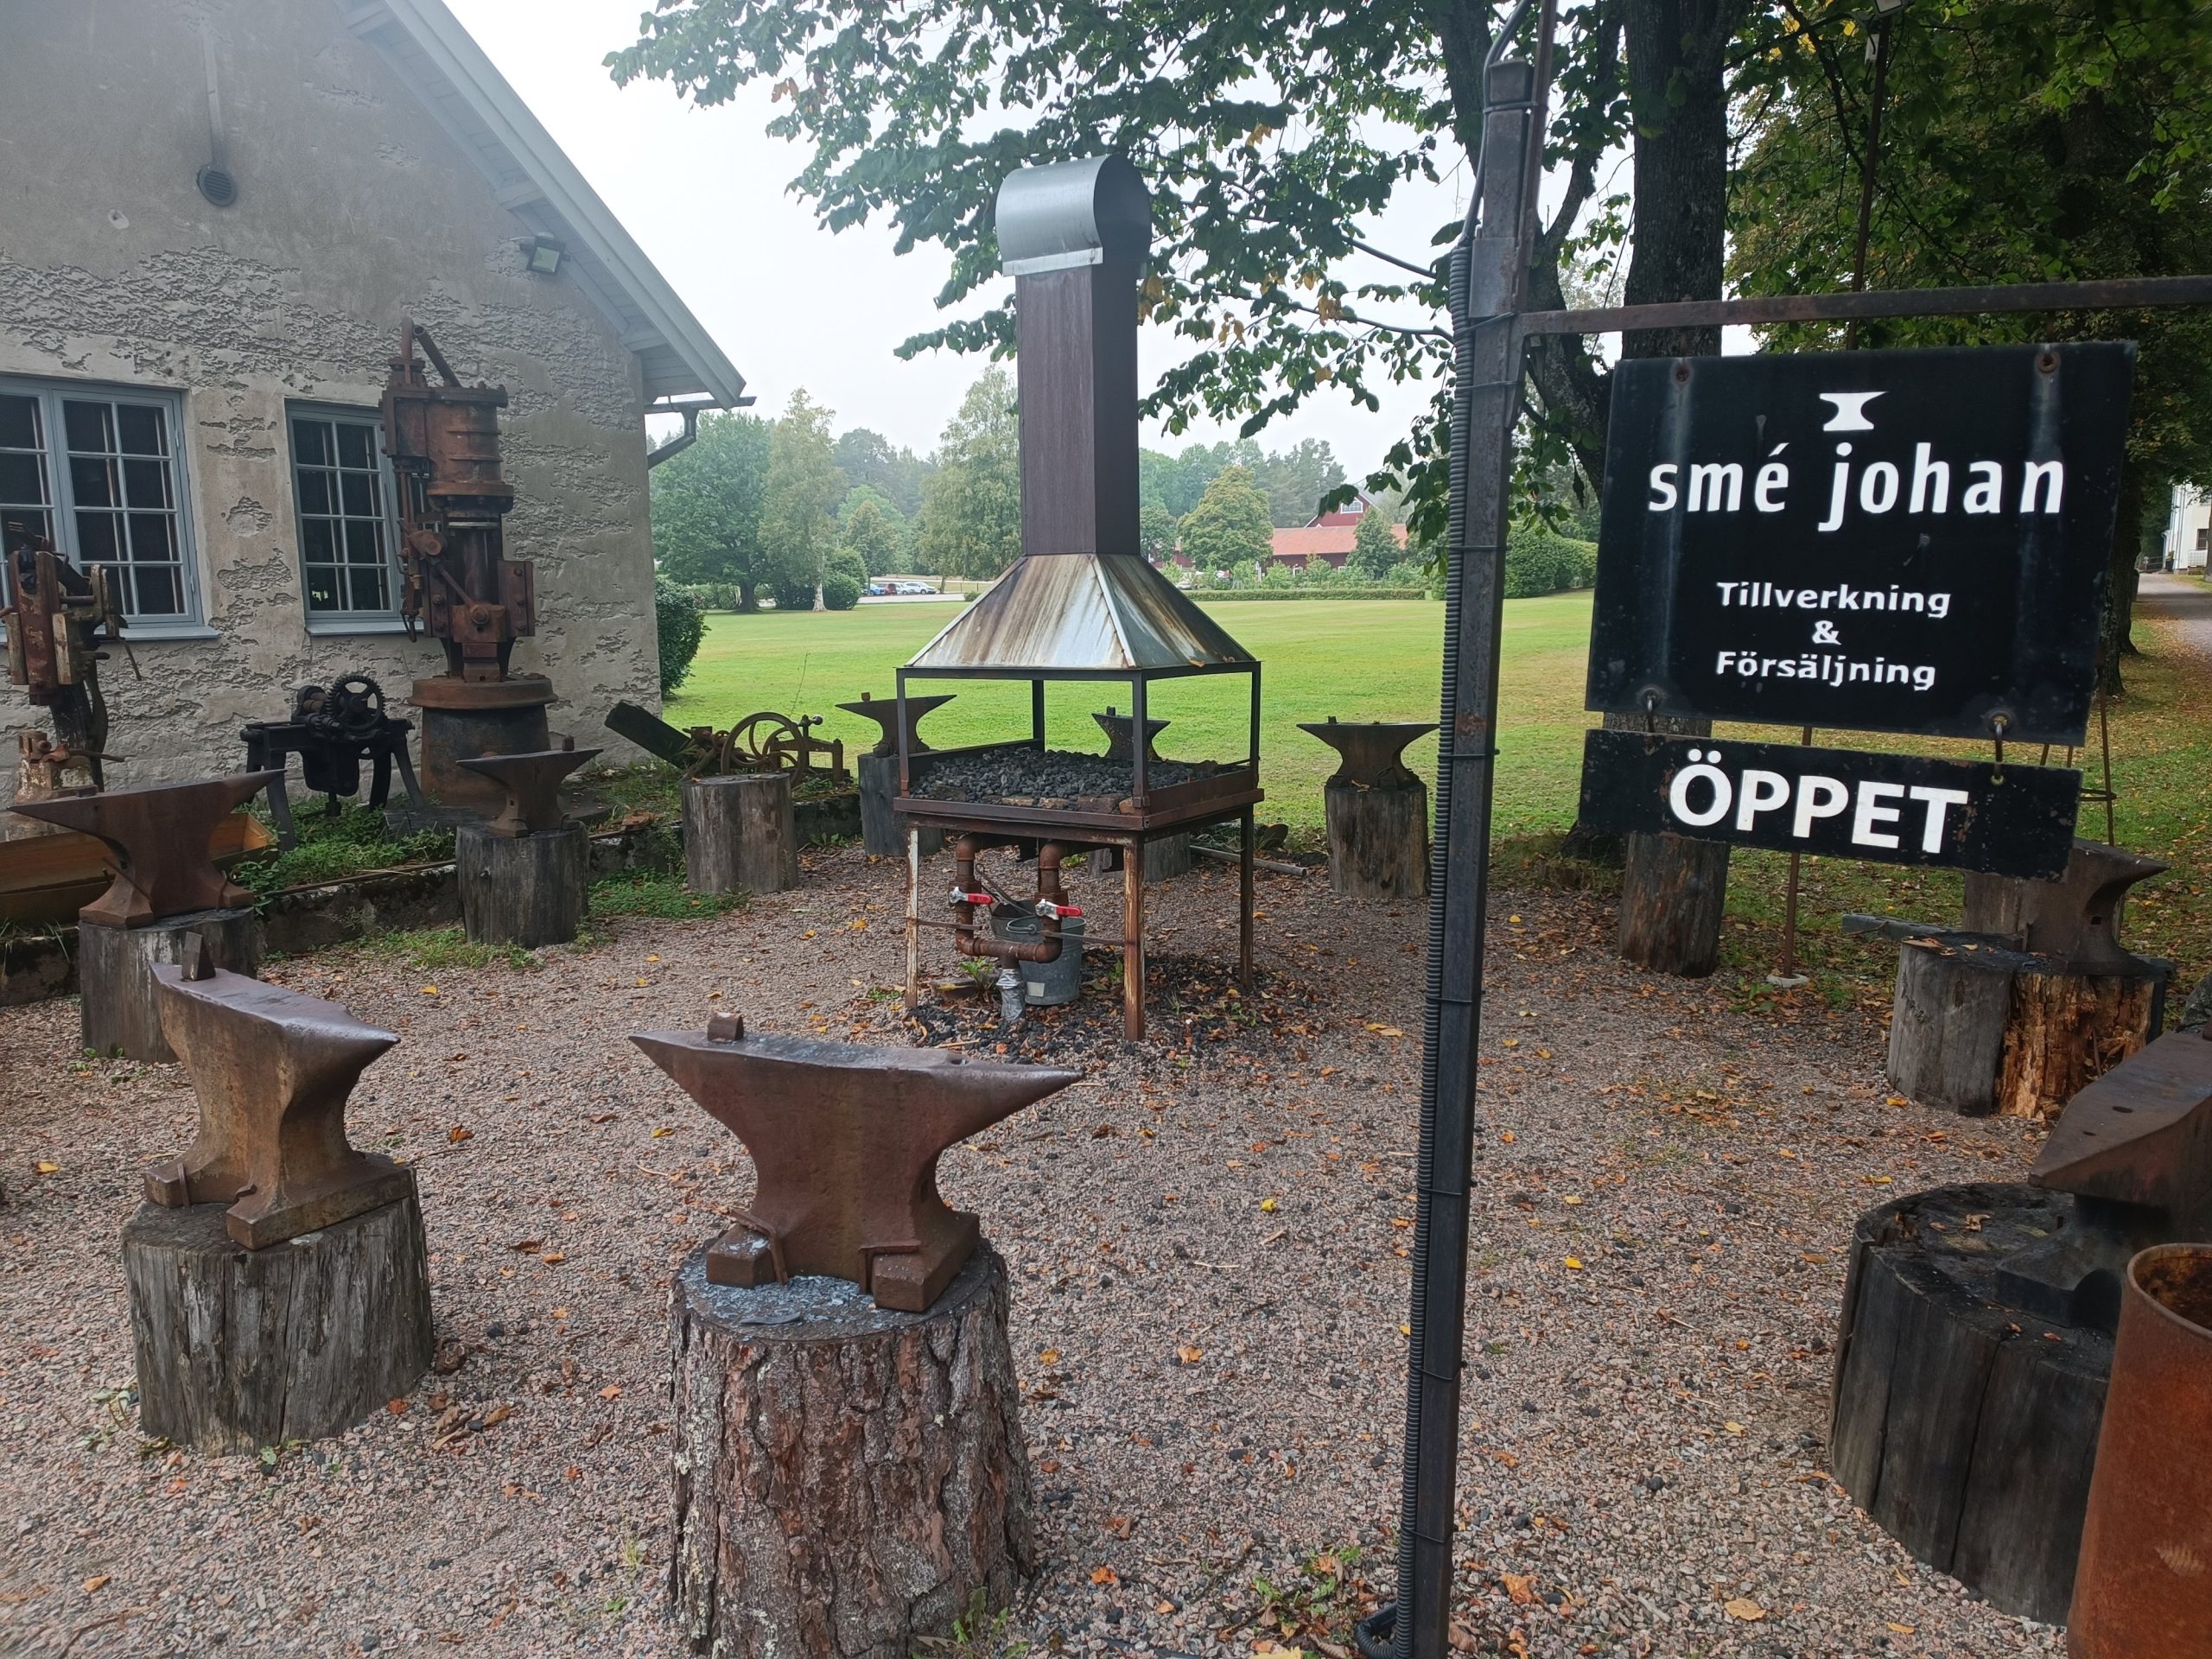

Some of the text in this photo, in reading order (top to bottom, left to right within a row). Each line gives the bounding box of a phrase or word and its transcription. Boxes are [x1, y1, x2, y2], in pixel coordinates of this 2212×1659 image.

[1649, 442, 2063, 531] smé johan
[1718, 582, 1950, 618] Tillverkning
[1813, 620, 1841, 645] &
[1717, 652, 1935, 690] Försäljning
[1670, 748, 1967, 853] ÖPPET
